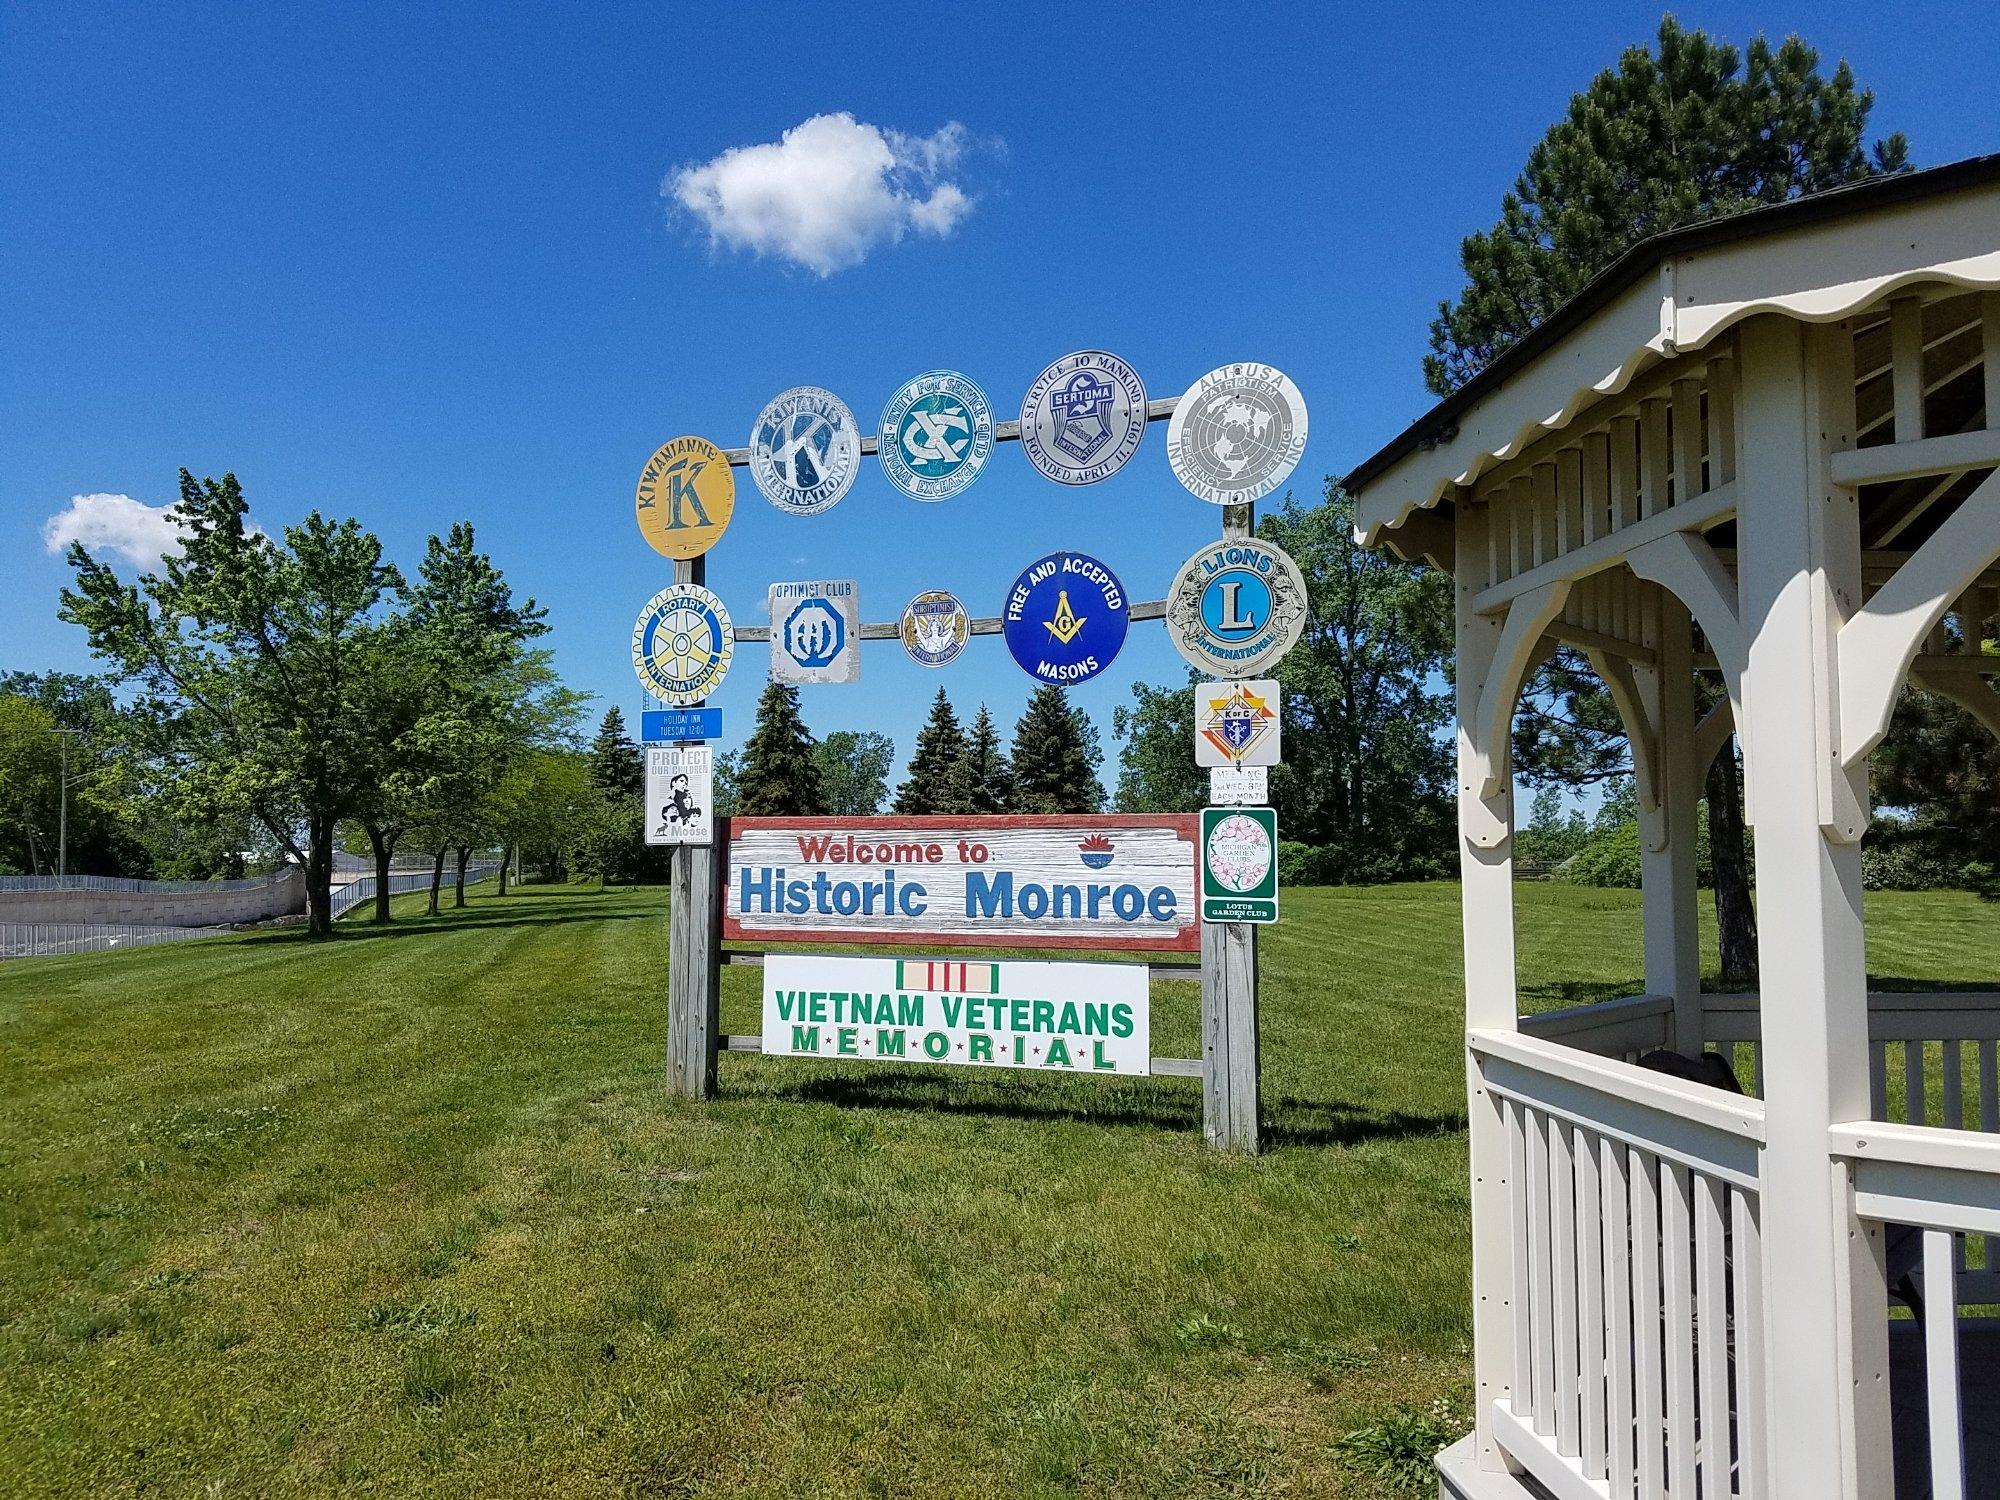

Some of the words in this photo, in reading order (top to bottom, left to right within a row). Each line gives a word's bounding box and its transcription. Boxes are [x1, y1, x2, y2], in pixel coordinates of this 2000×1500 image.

[1024, 363, 1066, 419] SERVICE
[1073, 355, 1090, 368] TO
[1096, 356, 1142, 403] MANKIND
[1055, 387, 1110, 405] SERTOMA
[1201, 377, 1278, 403] PATRIOTISM
[767, 396, 839, 429] KIWANIS
[886, 388, 914, 426] UNITY
[917, 378, 941, 395] FOR
[945, 378, 987, 418] SERVICE
[883, 432, 914, 488] NATIONAL
[916, 462, 977, 495] EXCHANGE
[973, 423, 990, 459] CLUB
[1025, 436, 1071, 481] FOUNDED
[1075, 462, 1114, 482] APRIL
[1126, 420, 1142, 446] 1912
[1182, 427, 1224, 488] EFFICIENCY
[1260, 422, 1292, 477] SERVICE
[638, 439, 718, 510] KIWANIANNE
[664, 457, 716, 530] K
[1201, 547, 1273, 574] LIONS
[776, 583, 819, 598] OPTIMIST
[826, 582, 852, 597] CLUB
[1008, 583, 1031, 621] FREE
[1029, 561, 1057, 587] AND
[1062, 557, 1122, 610] ACCEPTED
[662, 598, 704, 614] ROTARY
[1218, 581, 1256, 632] L
[1058, 615, 1072, 633] G
[1194, 630, 1277, 660] INTERNATIONAL
[646, 656, 719, 692] INTERNATIONAL
[1036, 655, 1099, 680] MASONS
[663, 714, 688, 725] HOLIDAY
[691, 714, 701, 724] INN
[1225, 710, 1233, 718] K
[1243, 710, 1250, 718] C
[660, 725, 686, 736] TUESDAY
[652, 750, 709, 766] PROTECT
[652, 765, 669, 775] OUR
[672, 764, 708, 775] CHILDREN
[671, 825, 708, 837] Moose
[797, 835, 944, 864] Welcome
[740, 866, 928, 917] Historic
[965, 871, 1178, 922] Monroe
[1211, 909, 1246, 917] GARDEN
[775, 990, 925, 1027] VIETNAM
[941, 996, 1134, 1039] VETERANS
